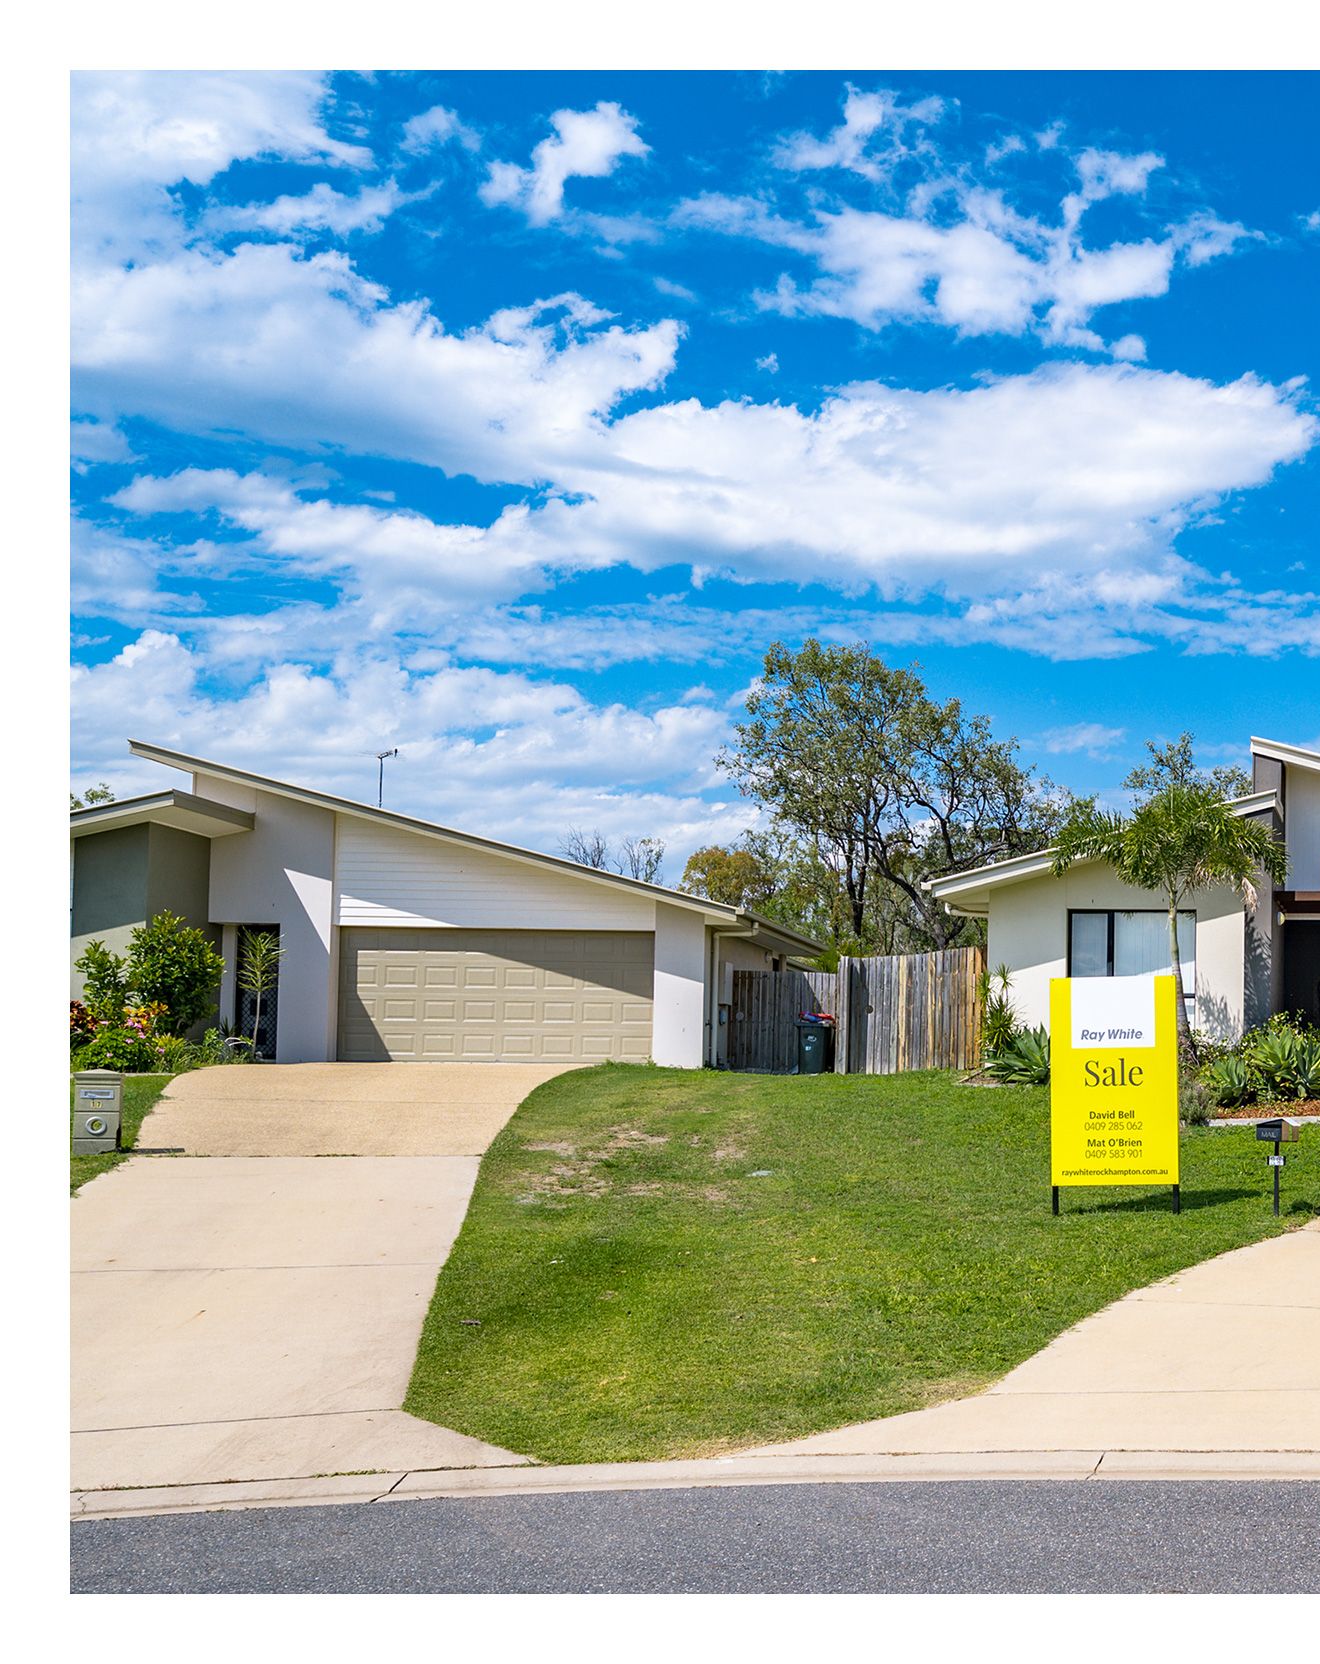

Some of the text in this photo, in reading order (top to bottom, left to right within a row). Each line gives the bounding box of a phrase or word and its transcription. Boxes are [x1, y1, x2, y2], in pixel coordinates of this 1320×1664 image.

[1081, 1028, 1143, 1042] Ray White
[1084, 1057, 1144, 1087] Sale
[1089, 1110, 1135, 1120] David Bell
[1084, 1121, 1143, 1131] 0409 285 062
[1087, 1138, 1143, 1147] Mat O'Brien
[1085, 1149, 1143, 1159] 0409 583 901
[1061, 1168, 1169, 1177] raywhiterockhampton.com.au
